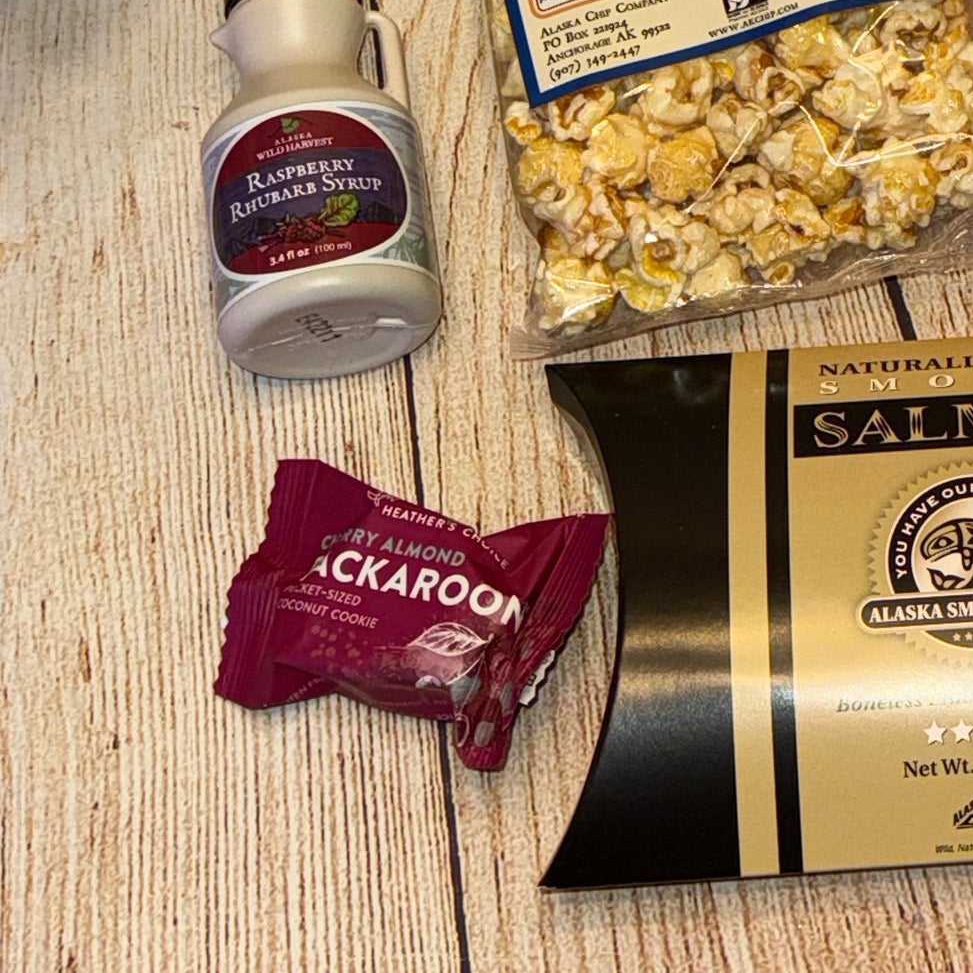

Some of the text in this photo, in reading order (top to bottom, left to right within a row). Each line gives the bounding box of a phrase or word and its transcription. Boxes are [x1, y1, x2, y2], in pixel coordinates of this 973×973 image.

[537, 18, 581, 38] ALASKA
[584, 6, 612, 22] CHIP
[541, 36, 562, 51] PO
[592, 19, 629, 38] 221924
[544, 22, 672, 65] ANCHORAGE AK 99522
[547, 44, 642, 82] (907) 349-2447
[256, 136, 335, 161] WILD HARVEST
[274, 132, 312, 146] ALASKA
[246, 158, 354, 195] RASPBERRY
[229, 172, 382, 224] RHUBARB SYRUP
[269, 241, 352, 267] 3.4 fl oz (100 ml)
[380, 536, 466, 567] ALMOND
[895, 540, 907, 579] YOU
[901, 493, 940, 538] HAVE
[276, 597, 379, 630] OCONUT COOKIE
[869, 602, 943, 624] ALASKA
[902, 760, 938, 778] Net
